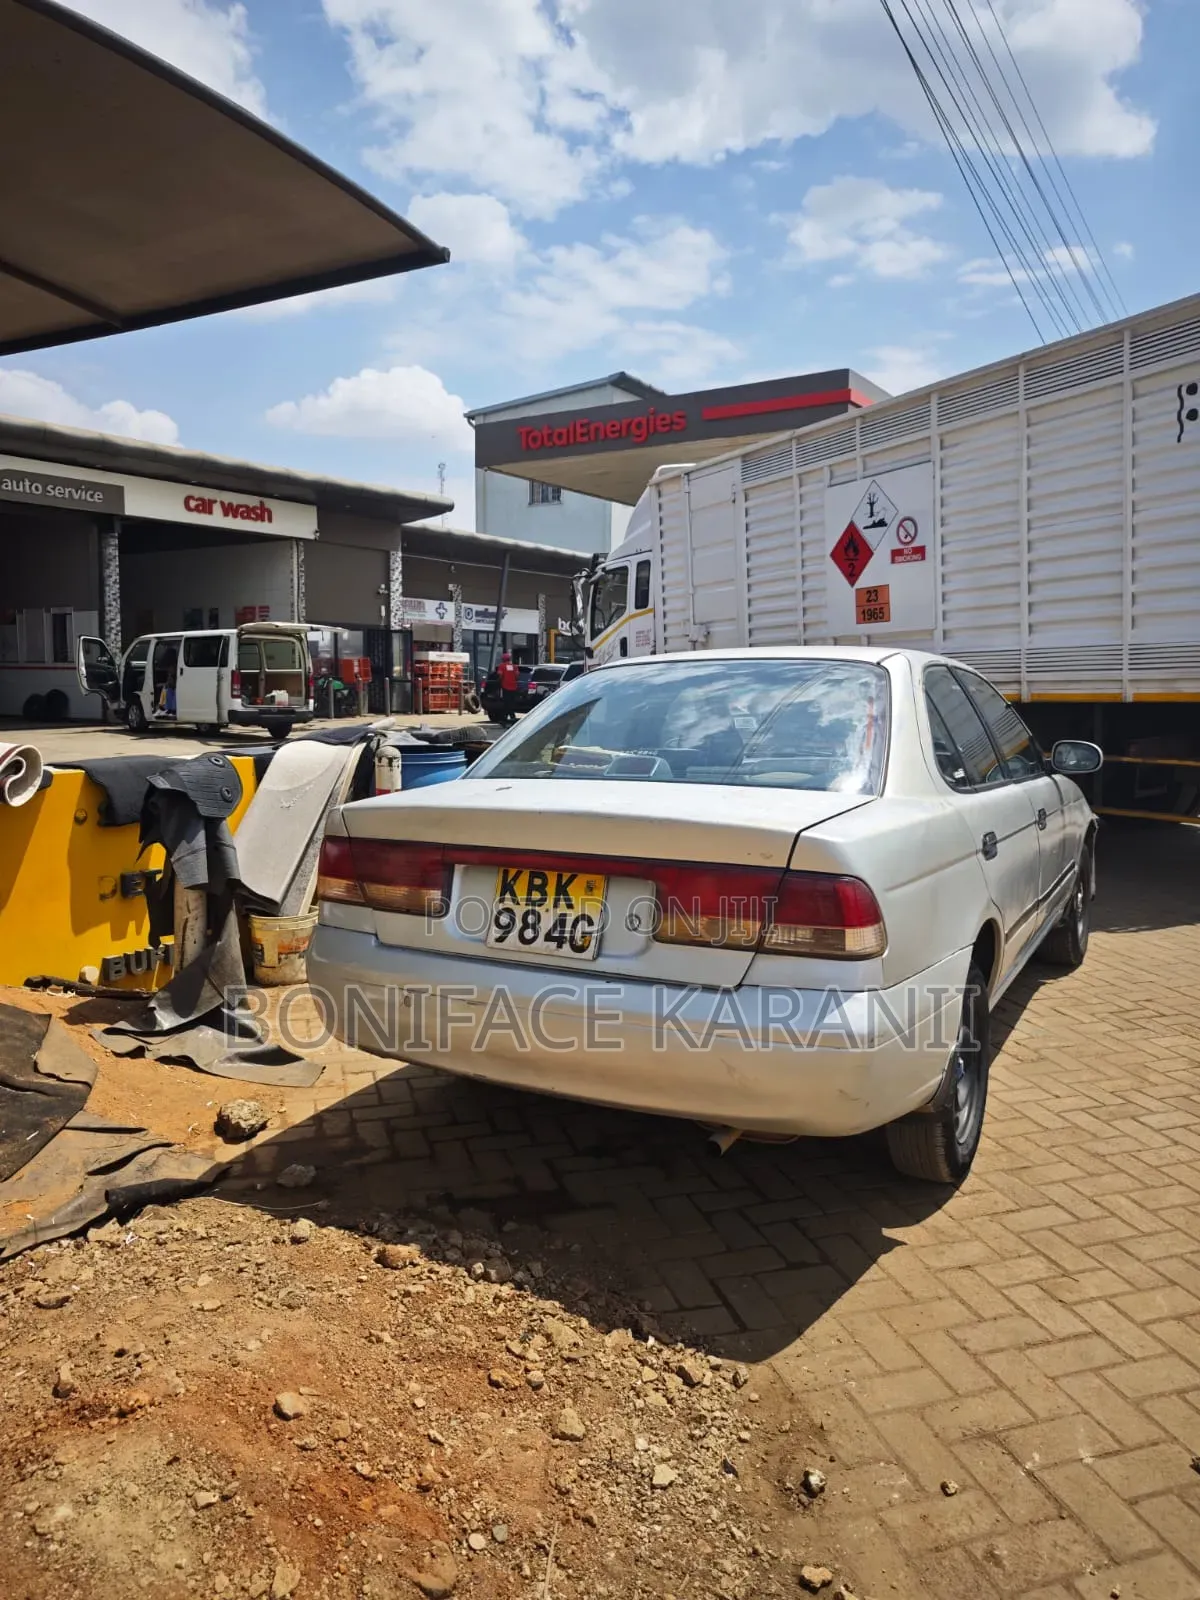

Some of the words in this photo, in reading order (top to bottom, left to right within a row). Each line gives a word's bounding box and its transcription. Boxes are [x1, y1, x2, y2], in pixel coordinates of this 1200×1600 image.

[517, 407, 687, 450] TotalEnergies
[1, 478, 42, 495] auto
[46, 484, 104, 503] service
[184, 495, 217, 515] car
[220, 500, 273, 523] wash
[894, 554, 922, 563] SMOKING
[903, 546, 912, 554] NO
[848, 563, 856, 578] 2
[866, 589, 879, 603] 23
[861, 607, 885, 621] 1965
[498, 868, 578, 909] KBK
[494, 907, 595, 954] 984G
